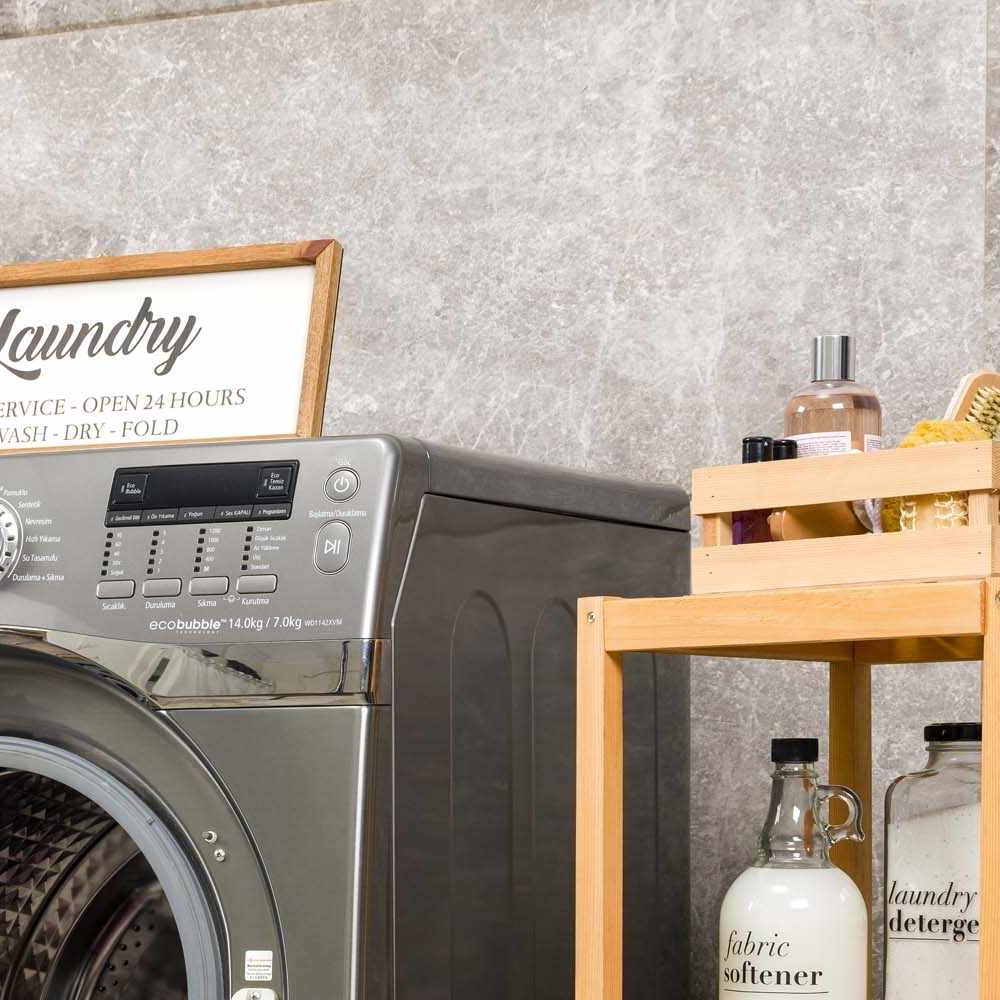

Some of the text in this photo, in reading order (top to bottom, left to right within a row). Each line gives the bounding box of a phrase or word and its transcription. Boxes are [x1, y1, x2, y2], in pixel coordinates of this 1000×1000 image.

[82, 393, 139, 415] OPEN
[144, 392, 167, 411] 24
[169, 387, 247, 409] HOURS
[63, 422, 106, 441] DRY
[121, 418, 179, 439] FOLD
[229, 617, 263, 631] 14.0kg
[273, 616, 302, 630] 7.0kg
[888, 881, 978, 914] laundry
[723, 930, 790, 961] fabric
[723, 961, 823, 986] softener
